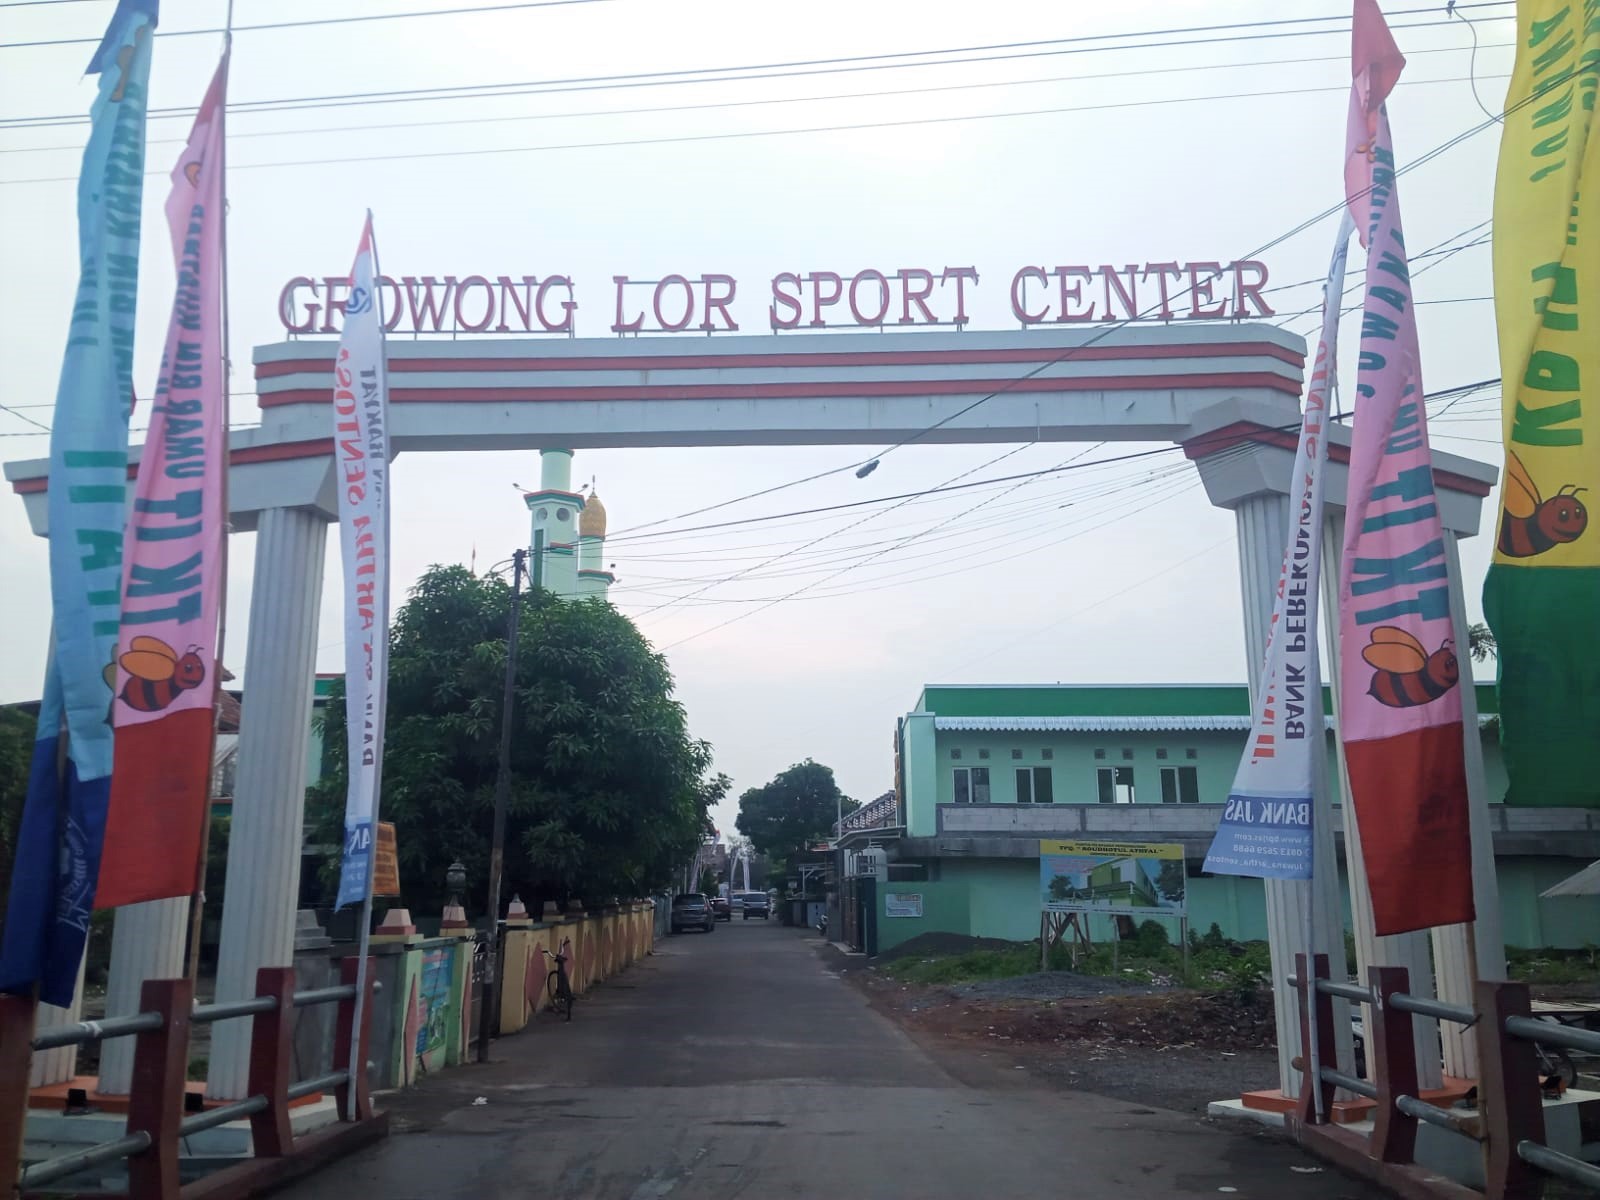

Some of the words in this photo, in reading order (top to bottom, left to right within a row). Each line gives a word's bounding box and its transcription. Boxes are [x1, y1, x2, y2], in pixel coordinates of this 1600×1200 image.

[278, 274, 577, 333] GROWONG
[611, 273, 739, 332] LOR
[769, 266, 979, 329] SPORT
[1010, 260, 1276, 324] CENTER
